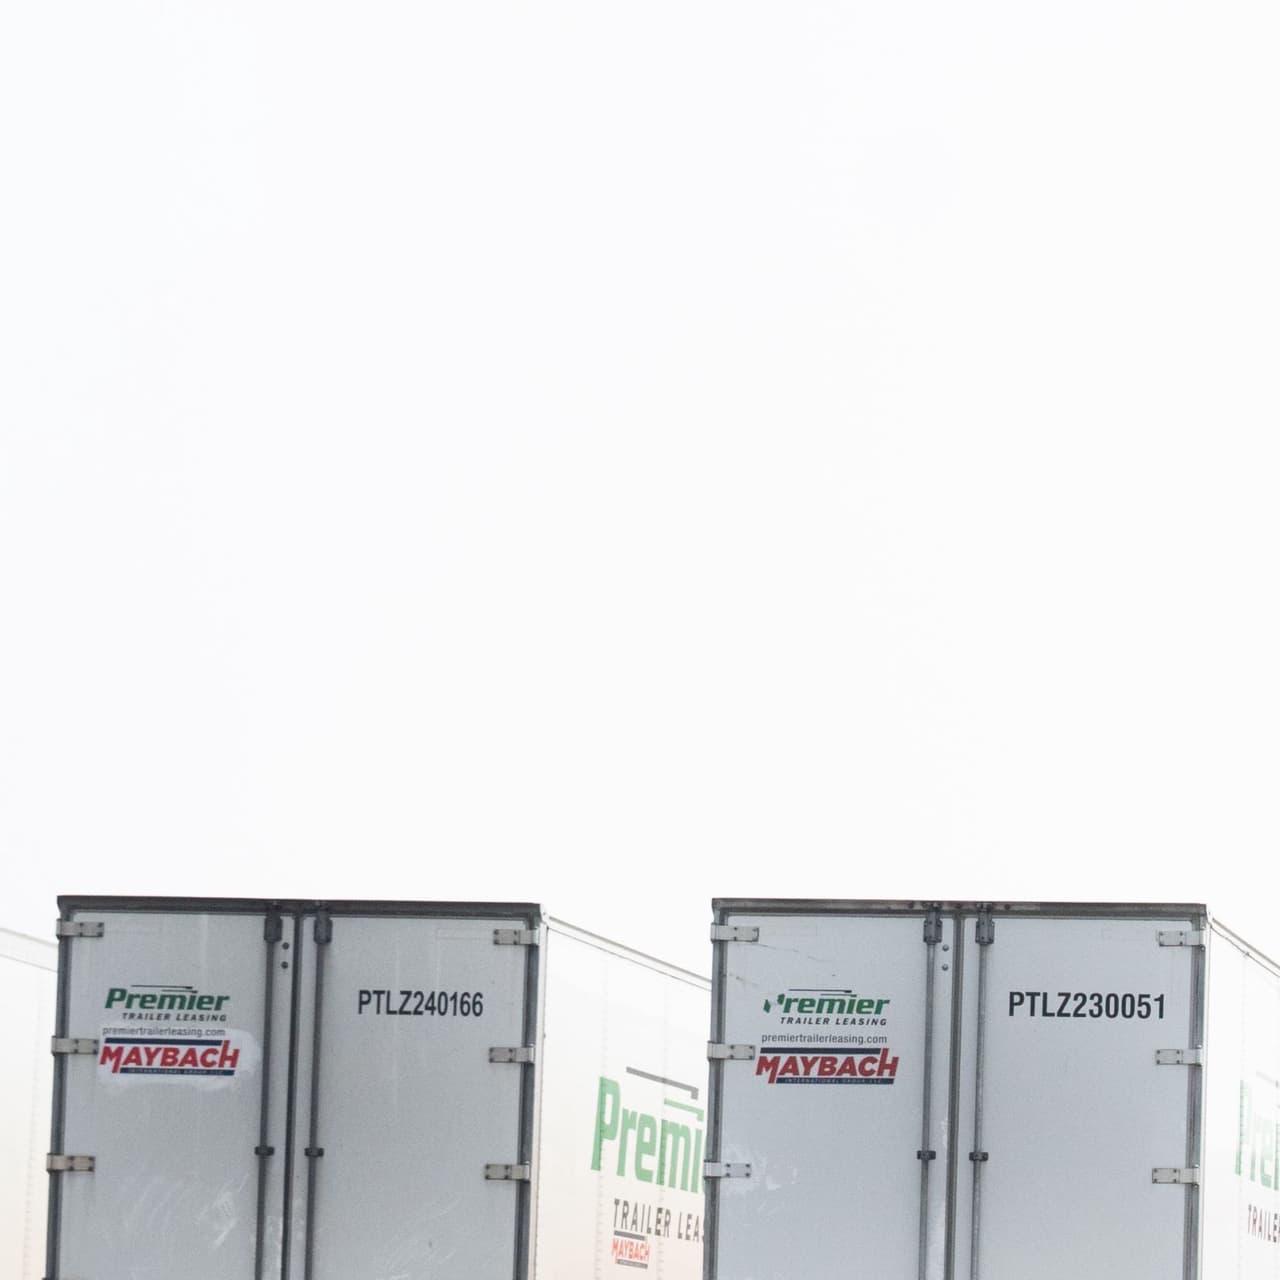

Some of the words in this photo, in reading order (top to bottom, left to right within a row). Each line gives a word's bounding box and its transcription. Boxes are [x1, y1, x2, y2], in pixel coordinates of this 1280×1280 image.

[105, 987, 230, 1011] Premier
[358, 989, 483, 1017] PTLZ240166
[1009, 991, 1164, 1019] PTLZ230051
[122, 1012, 171, 1021] TRAILER
[176, 1013, 227, 1022] LEASING
[781, 1017, 830, 1025] TRAILER
[836, 1017, 887, 1026] LEASING
[102, 1026, 225, 1038] premiertrailerleasing.com
[761, 1032, 888, 1045] premiertrailerleasing.com
[100, 1040, 240, 1073] MAYBACH
[755, 1048, 899, 1083] MAYBACH
[591, 1076, 705, 1193] Premi
[613, 1198, 672, 1238] TRAILER
[678, 1211, 705, 1243] LEA
